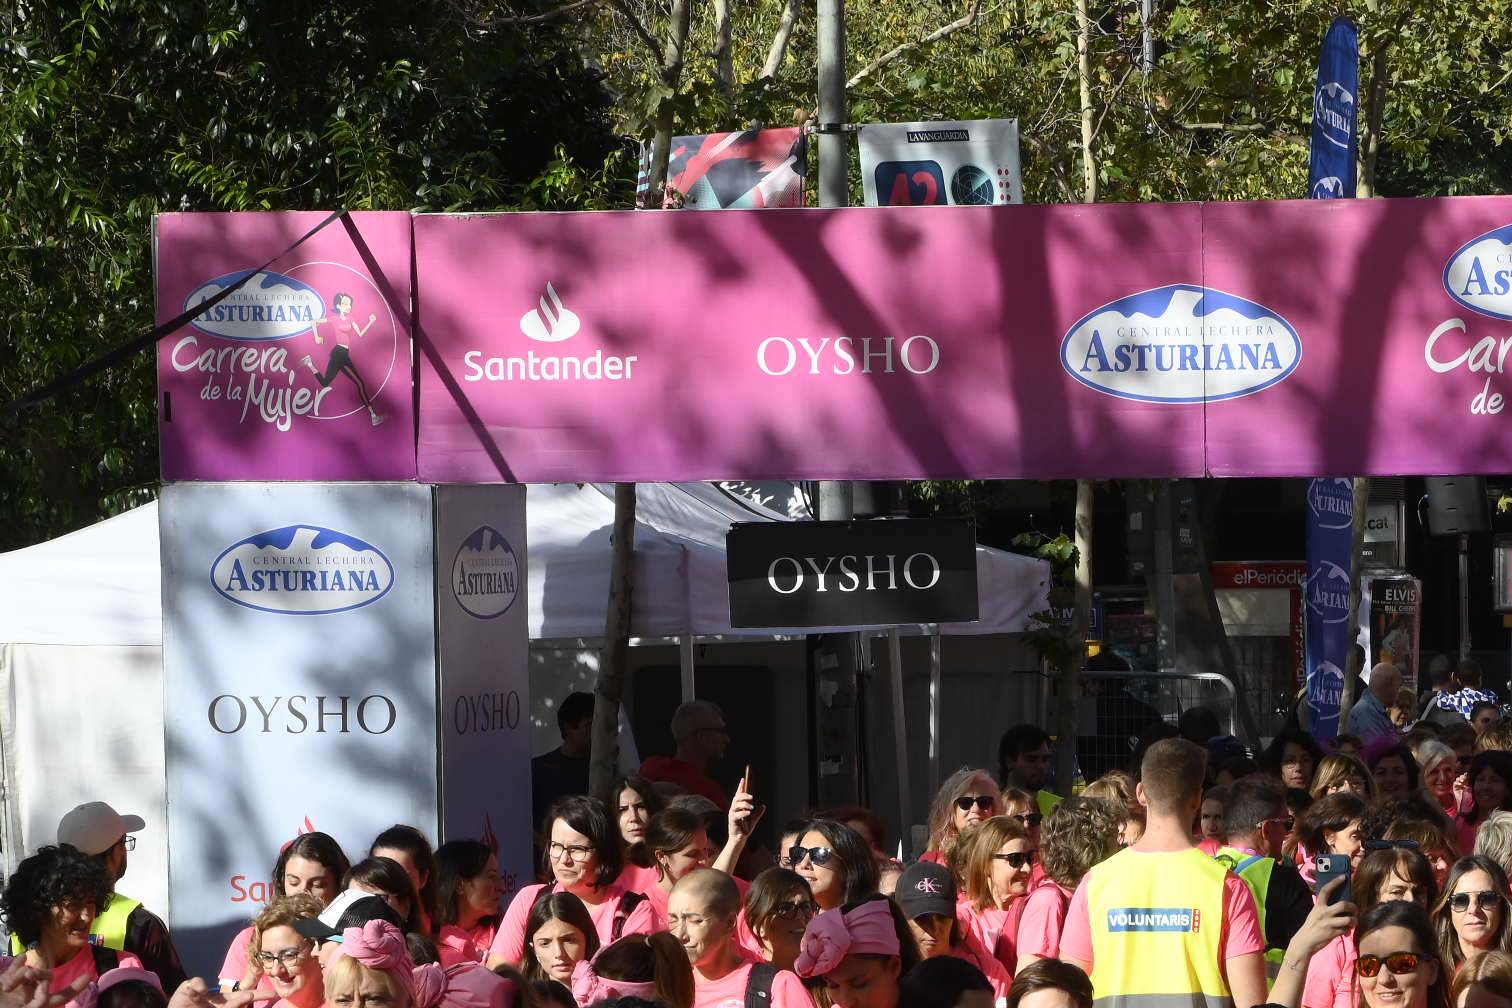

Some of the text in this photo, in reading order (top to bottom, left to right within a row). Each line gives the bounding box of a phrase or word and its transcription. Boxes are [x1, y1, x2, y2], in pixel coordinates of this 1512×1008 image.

[194, 296, 314, 322] ASTURIANA
[1116, 324, 1274, 338] CENTRAL LECHERA
[171, 335, 287, 373] Carrera
[464, 349, 637, 381] Santander
[756, 334, 940, 376] OYSHO
[1080, 329, 1282, 372] ASTURIANA
[200, 370, 333, 432] de la Mujer
[1471, 377, 1504, 415] de
[225, 558, 381, 592] ASTURIANA
[252, 555, 375, 565] CENTRAL LECHERA
[457, 560, 515, 596] ASTURIANA
[767, 552, 941, 594] OYSHO
[1385, 588, 1417, 601] ELVIS
[207, 694, 397, 735] OYSHO
[454, 690, 520, 736] OYSHO
[1108, 914, 1190, 927] VOLUNTARIS
